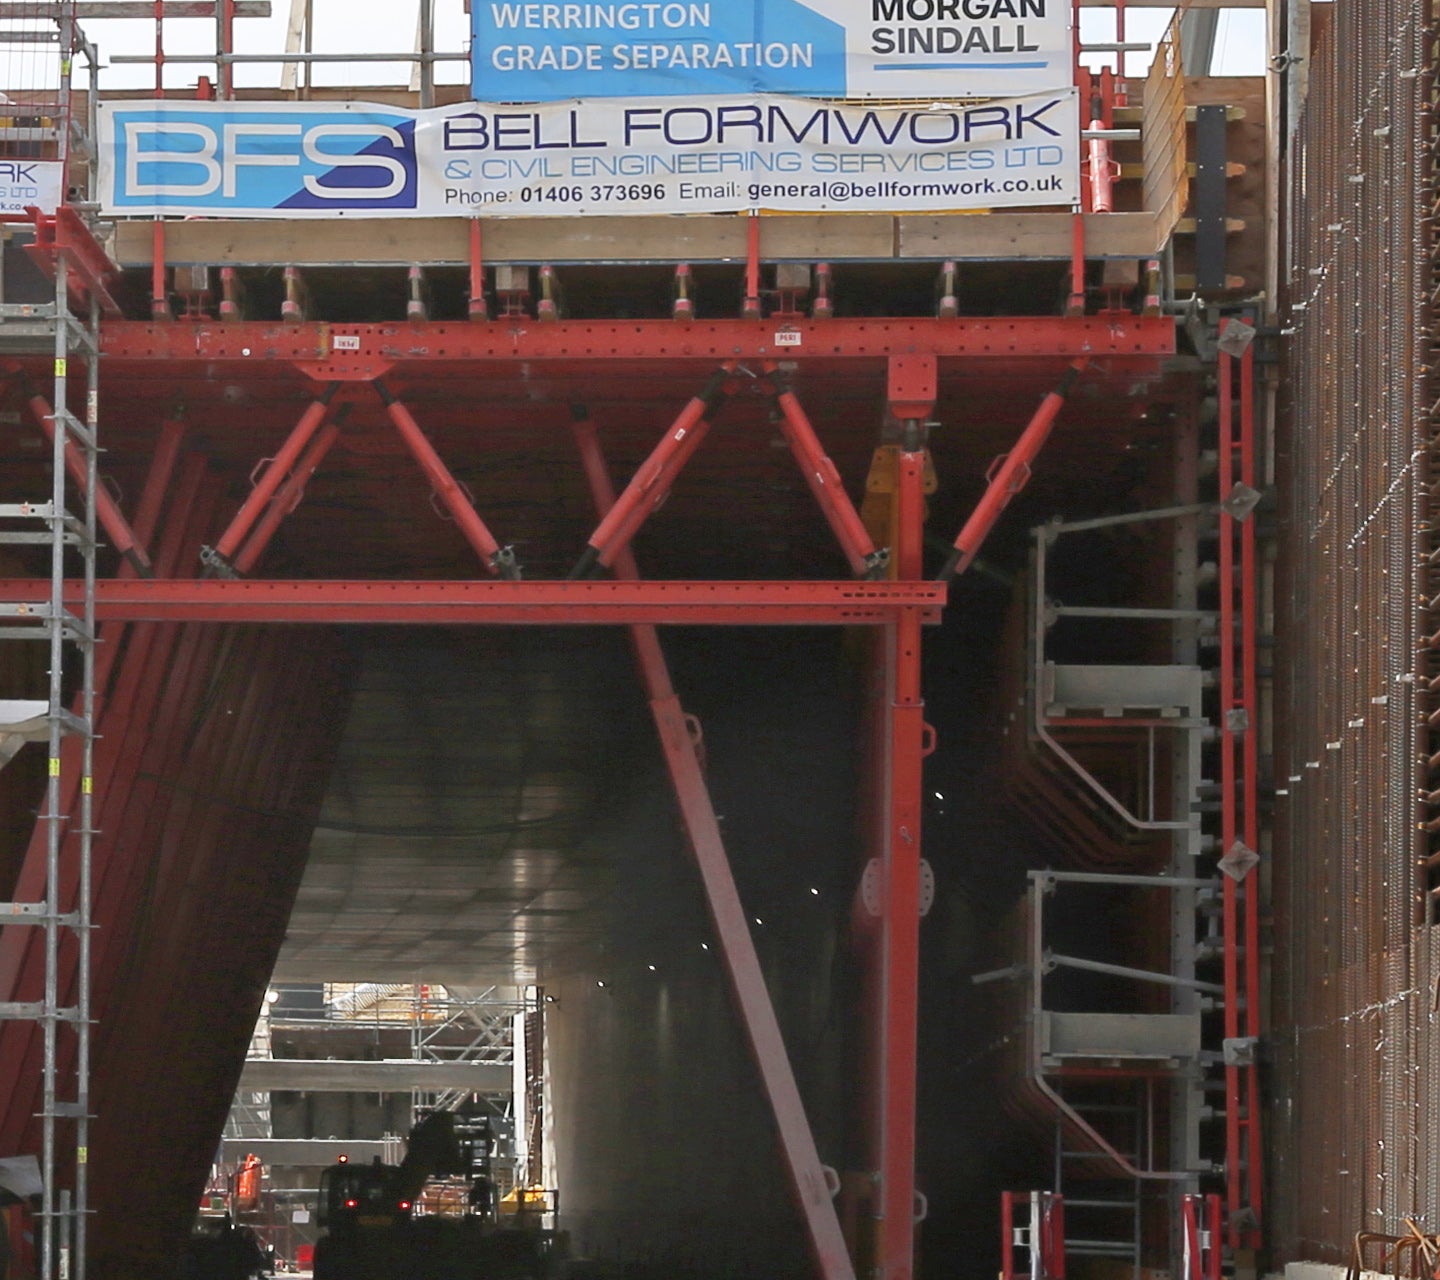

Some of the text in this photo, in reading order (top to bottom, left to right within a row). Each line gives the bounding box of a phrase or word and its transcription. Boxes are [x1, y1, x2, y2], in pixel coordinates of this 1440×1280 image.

[491, 2, 711, 29] WERRINGTON
[871, 25, 1040, 55] SINDALL
[491, 42, 813, 72] GRADE SEPARATION
[443, 99, 1062, 151] BELL FORMWORK
[124, 122, 407, 198] BFS
[444, 144, 1063, 180] & CIVIL ENGINEERING SERVICES LTD
[11, 186, 38, 199] LTD
[445, 174, 1064, 206] Phone: 01406 373696 Email: general@bellformwork.co.uk
